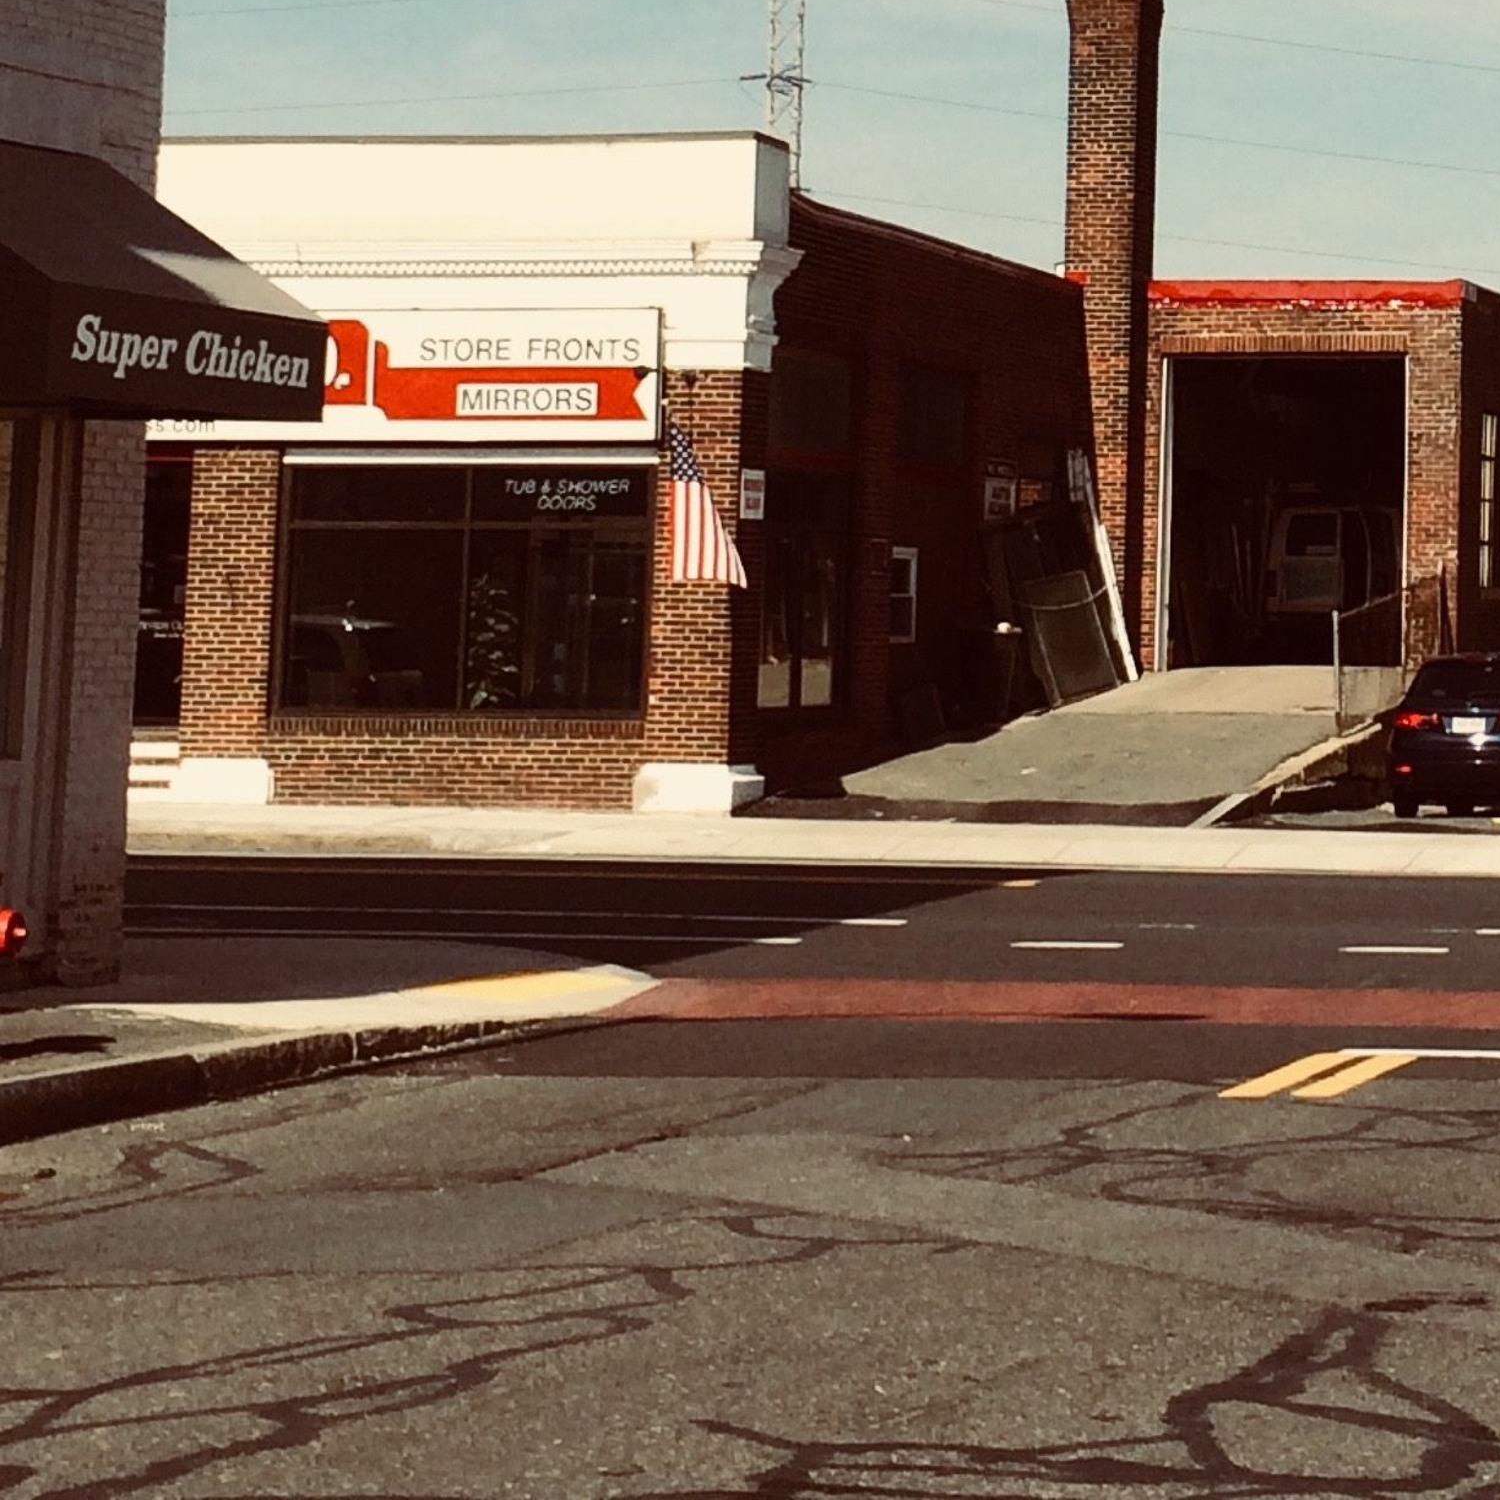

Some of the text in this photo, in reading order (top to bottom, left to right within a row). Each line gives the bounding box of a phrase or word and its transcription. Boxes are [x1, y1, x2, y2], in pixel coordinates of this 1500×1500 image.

[71, 314, 178, 379] Super
[184, 330, 310, 388] Chicken
[420, 337, 641, 362] STORE FRONTS
[460, 387, 593, 412] MIRRORS
[505, 479, 630, 495] TUB & SHOWER
[537, 495, 597, 512] DOORS
